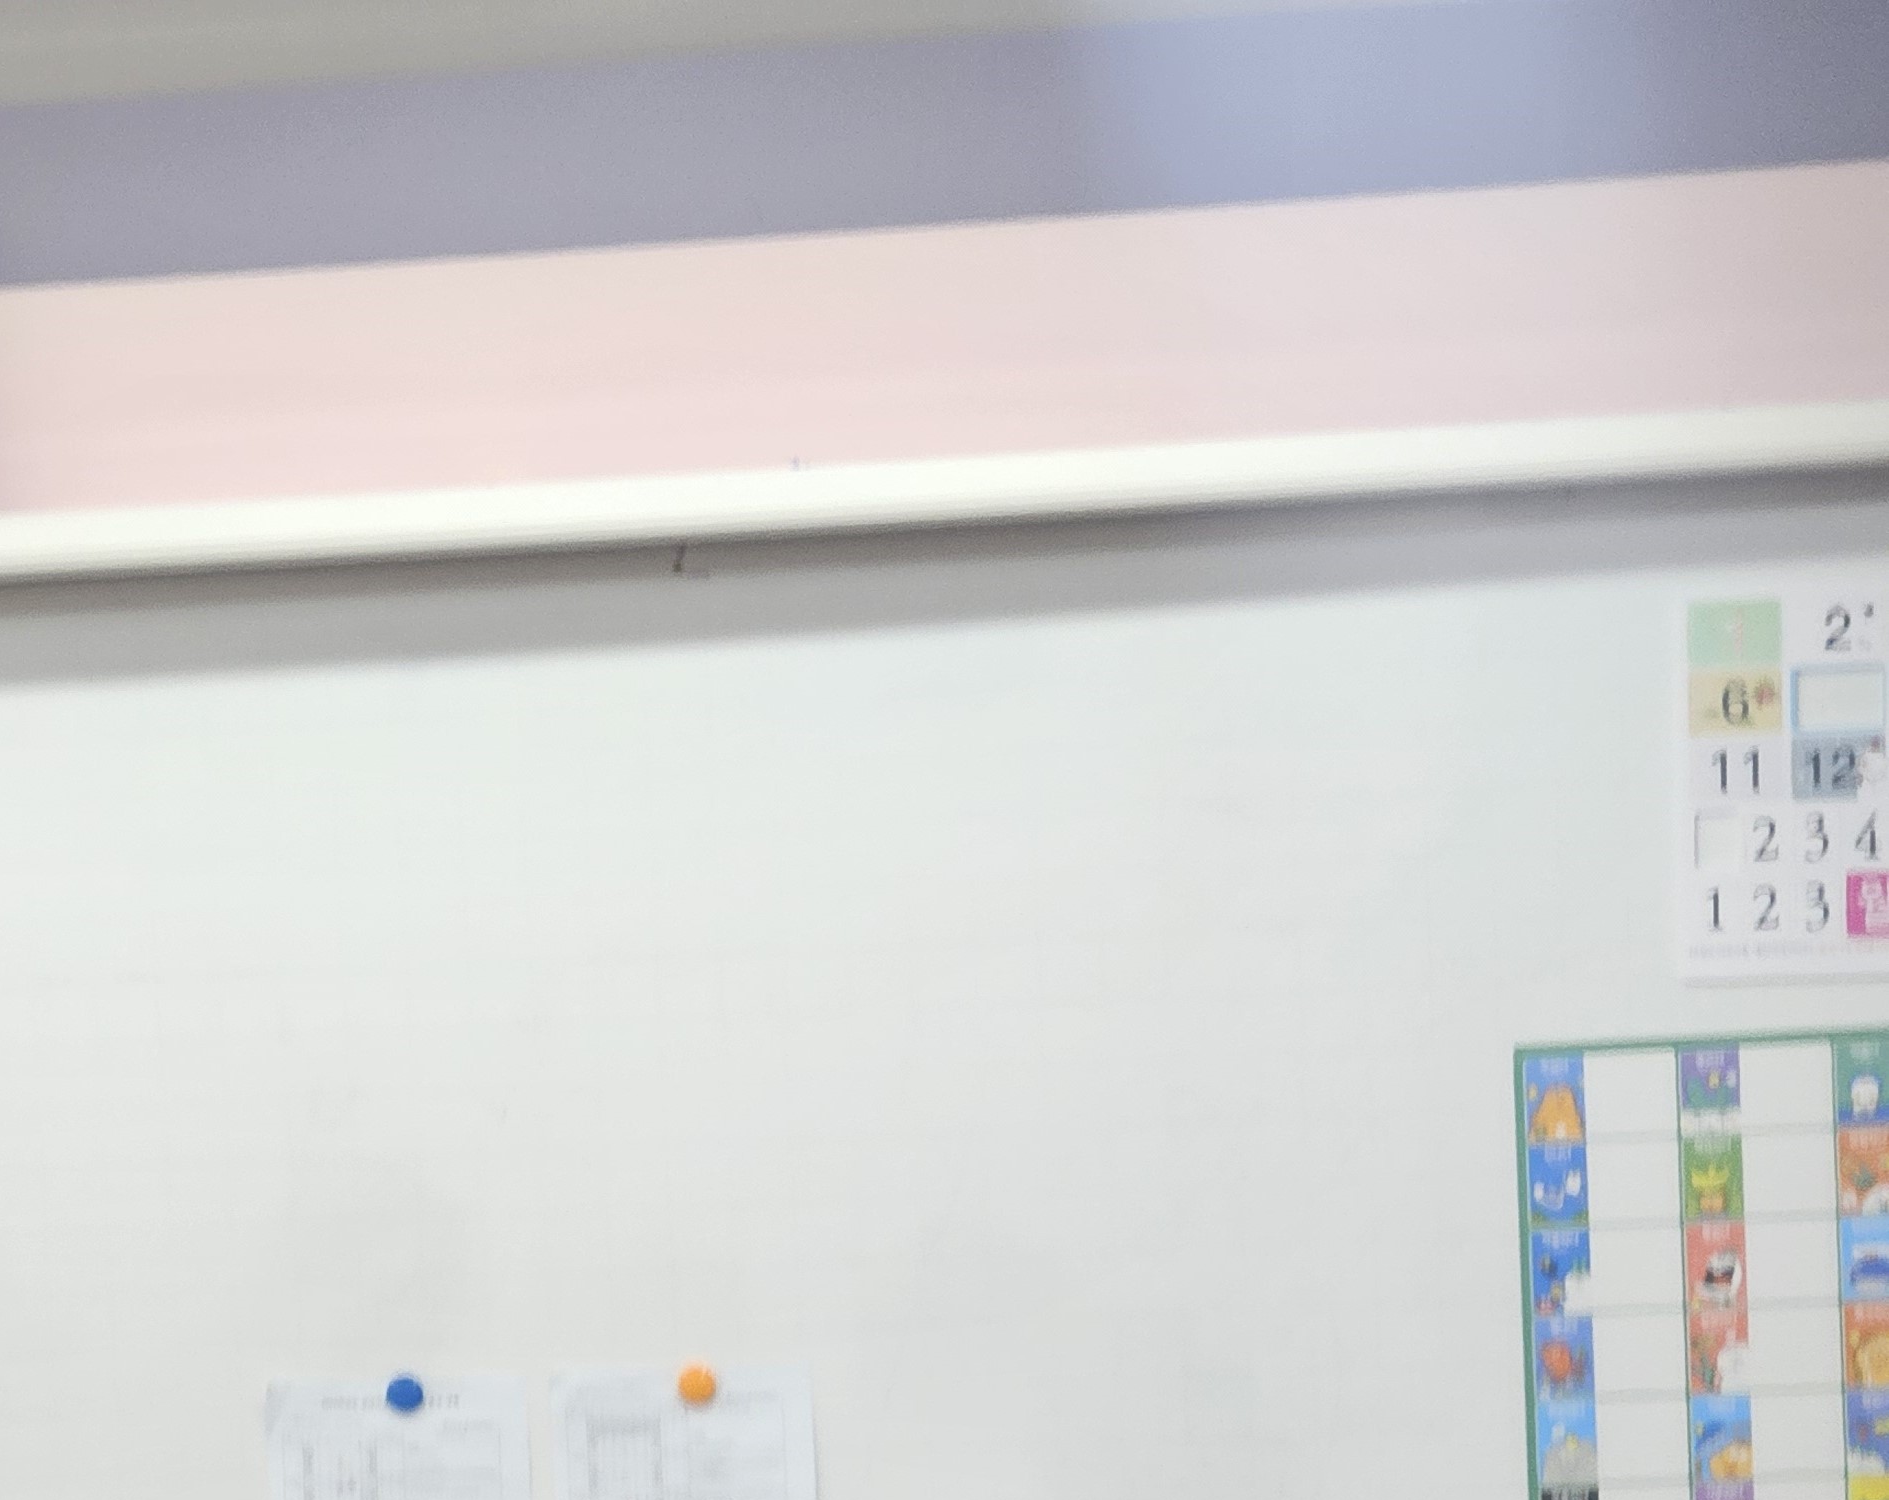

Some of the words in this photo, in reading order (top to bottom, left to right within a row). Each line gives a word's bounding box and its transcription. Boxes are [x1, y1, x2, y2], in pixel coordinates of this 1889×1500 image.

[1824, 605, 1851, 650] 2
[1722, 678, 1749, 727] 6
[1712, 747, 1760, 794] 11
[1807, 746, 1859, 790] 12
[1753, 815, 1779, 862] 2
[1805, 811, 1829, 864] 3
[1855, 809, 1880, 861] 4
[1707, 886, 1723, 932] 1
[1753, 883, 1779, 931] 2
[1806, 880, 1829, 933] 3
